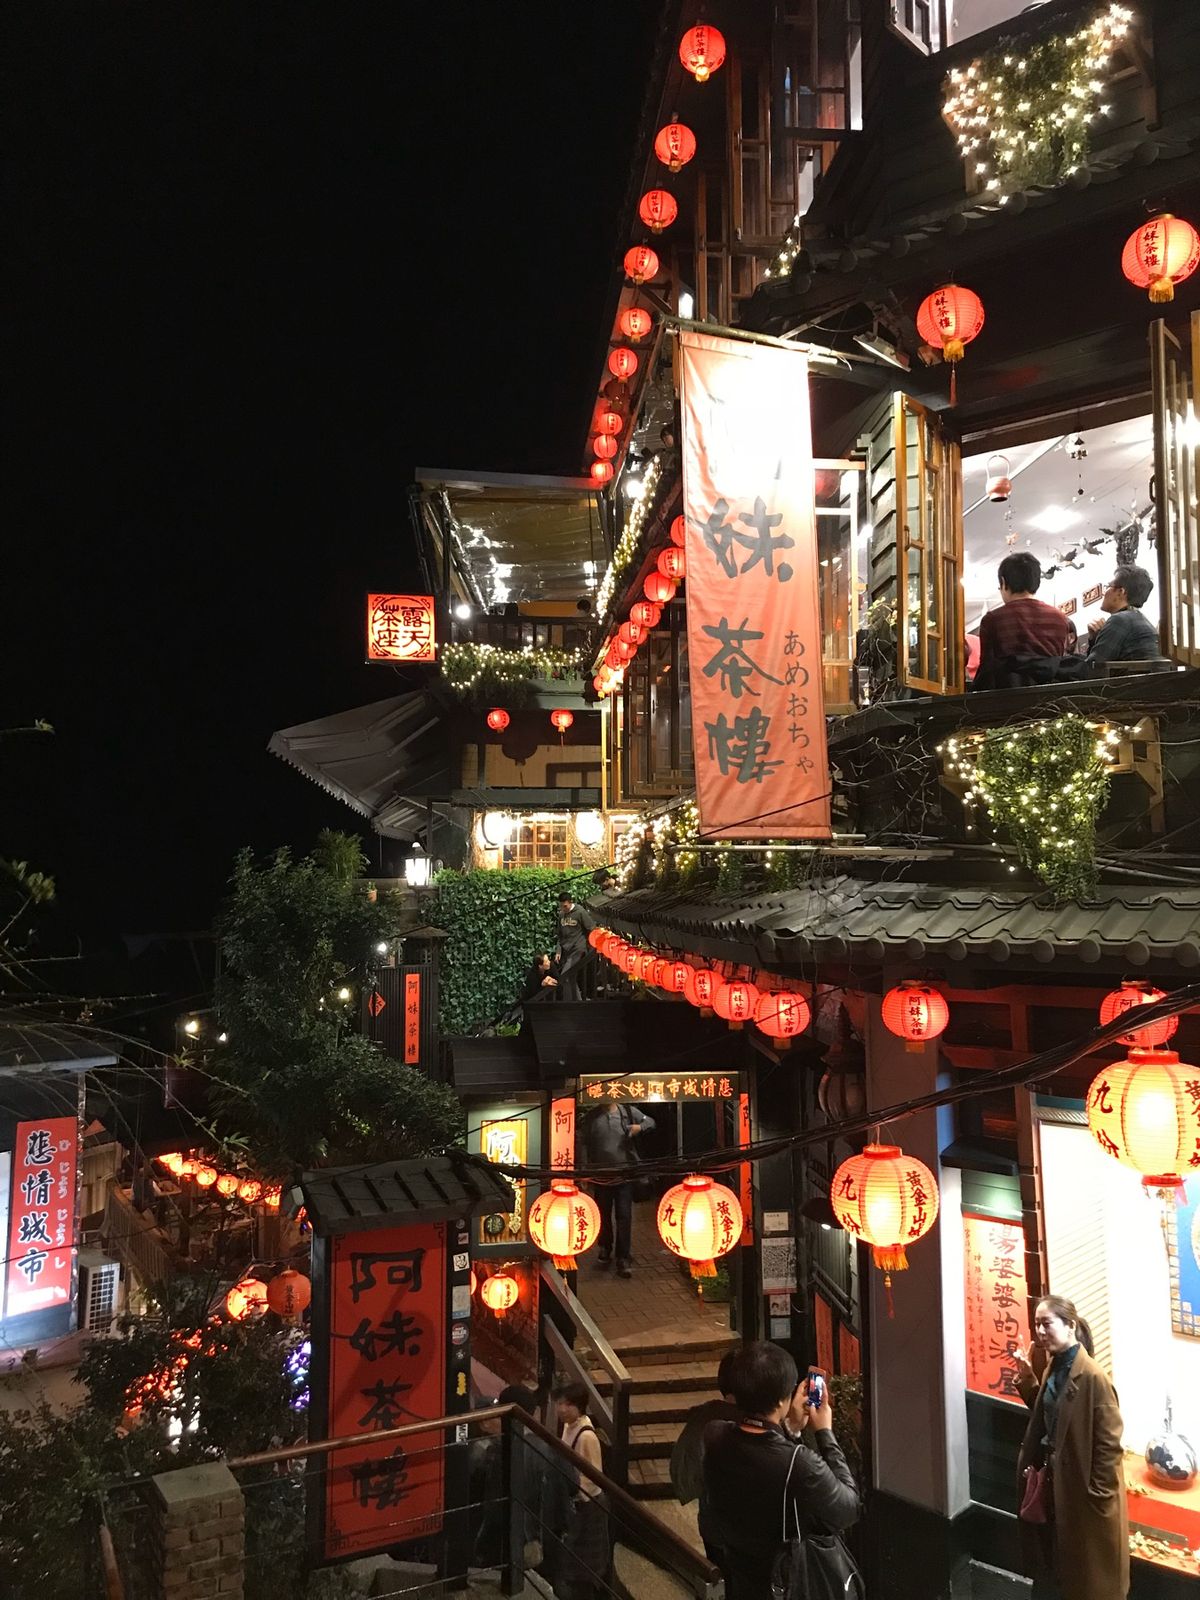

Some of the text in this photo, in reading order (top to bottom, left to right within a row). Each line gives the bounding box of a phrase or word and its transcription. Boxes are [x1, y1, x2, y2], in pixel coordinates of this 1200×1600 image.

[1144, 223, 1160, 268] 阿妹茶樓
[935, 290, 952, 329] 阿妹茶樓
[687, 394, 795, 784] 妹茶樓
[373, 605, 401, 648] 茶座
[401, 606, 431, 648] 露天
[407, 981, 419, 1056] 阿妹茶樓
[909, 996, 922, 1036] 阿妹茶樓
[17, 1130, 56, 1283] 悲情城市
[838, 1174, 862, 1236] 九份
[988, 1224, 1023, 1397] 湯婆婆的湯屋
[348, 1248, 428, 1511] 阿妹茶樓
